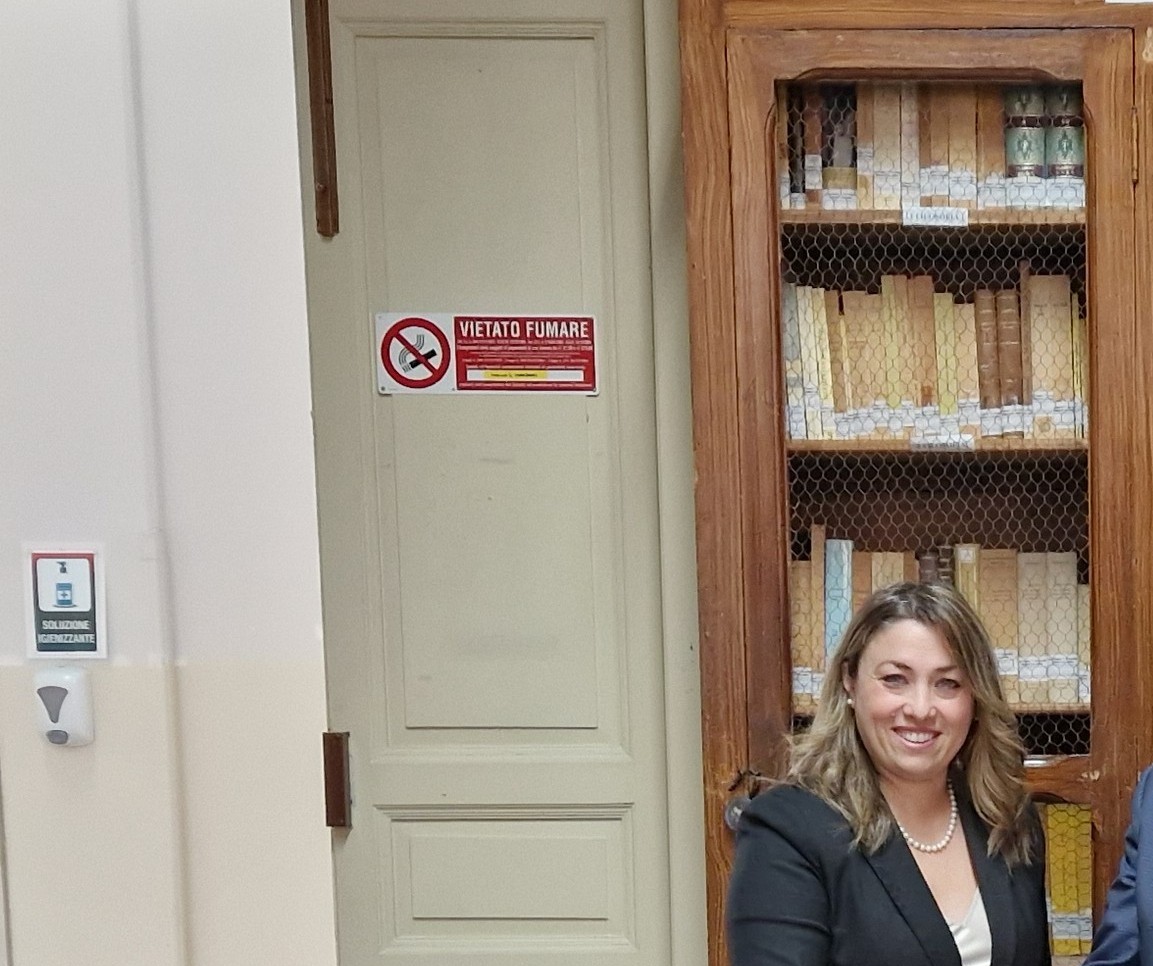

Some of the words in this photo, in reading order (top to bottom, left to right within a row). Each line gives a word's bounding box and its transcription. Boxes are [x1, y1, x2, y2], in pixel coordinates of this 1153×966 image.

[459, 320, 521, 338] VIETATO
[525, 320, 589, 339] FUMARE
[42, 619, 91, 630] SOLUZIONE
[38, 633, 96, 644] IGIENIZZANTE
